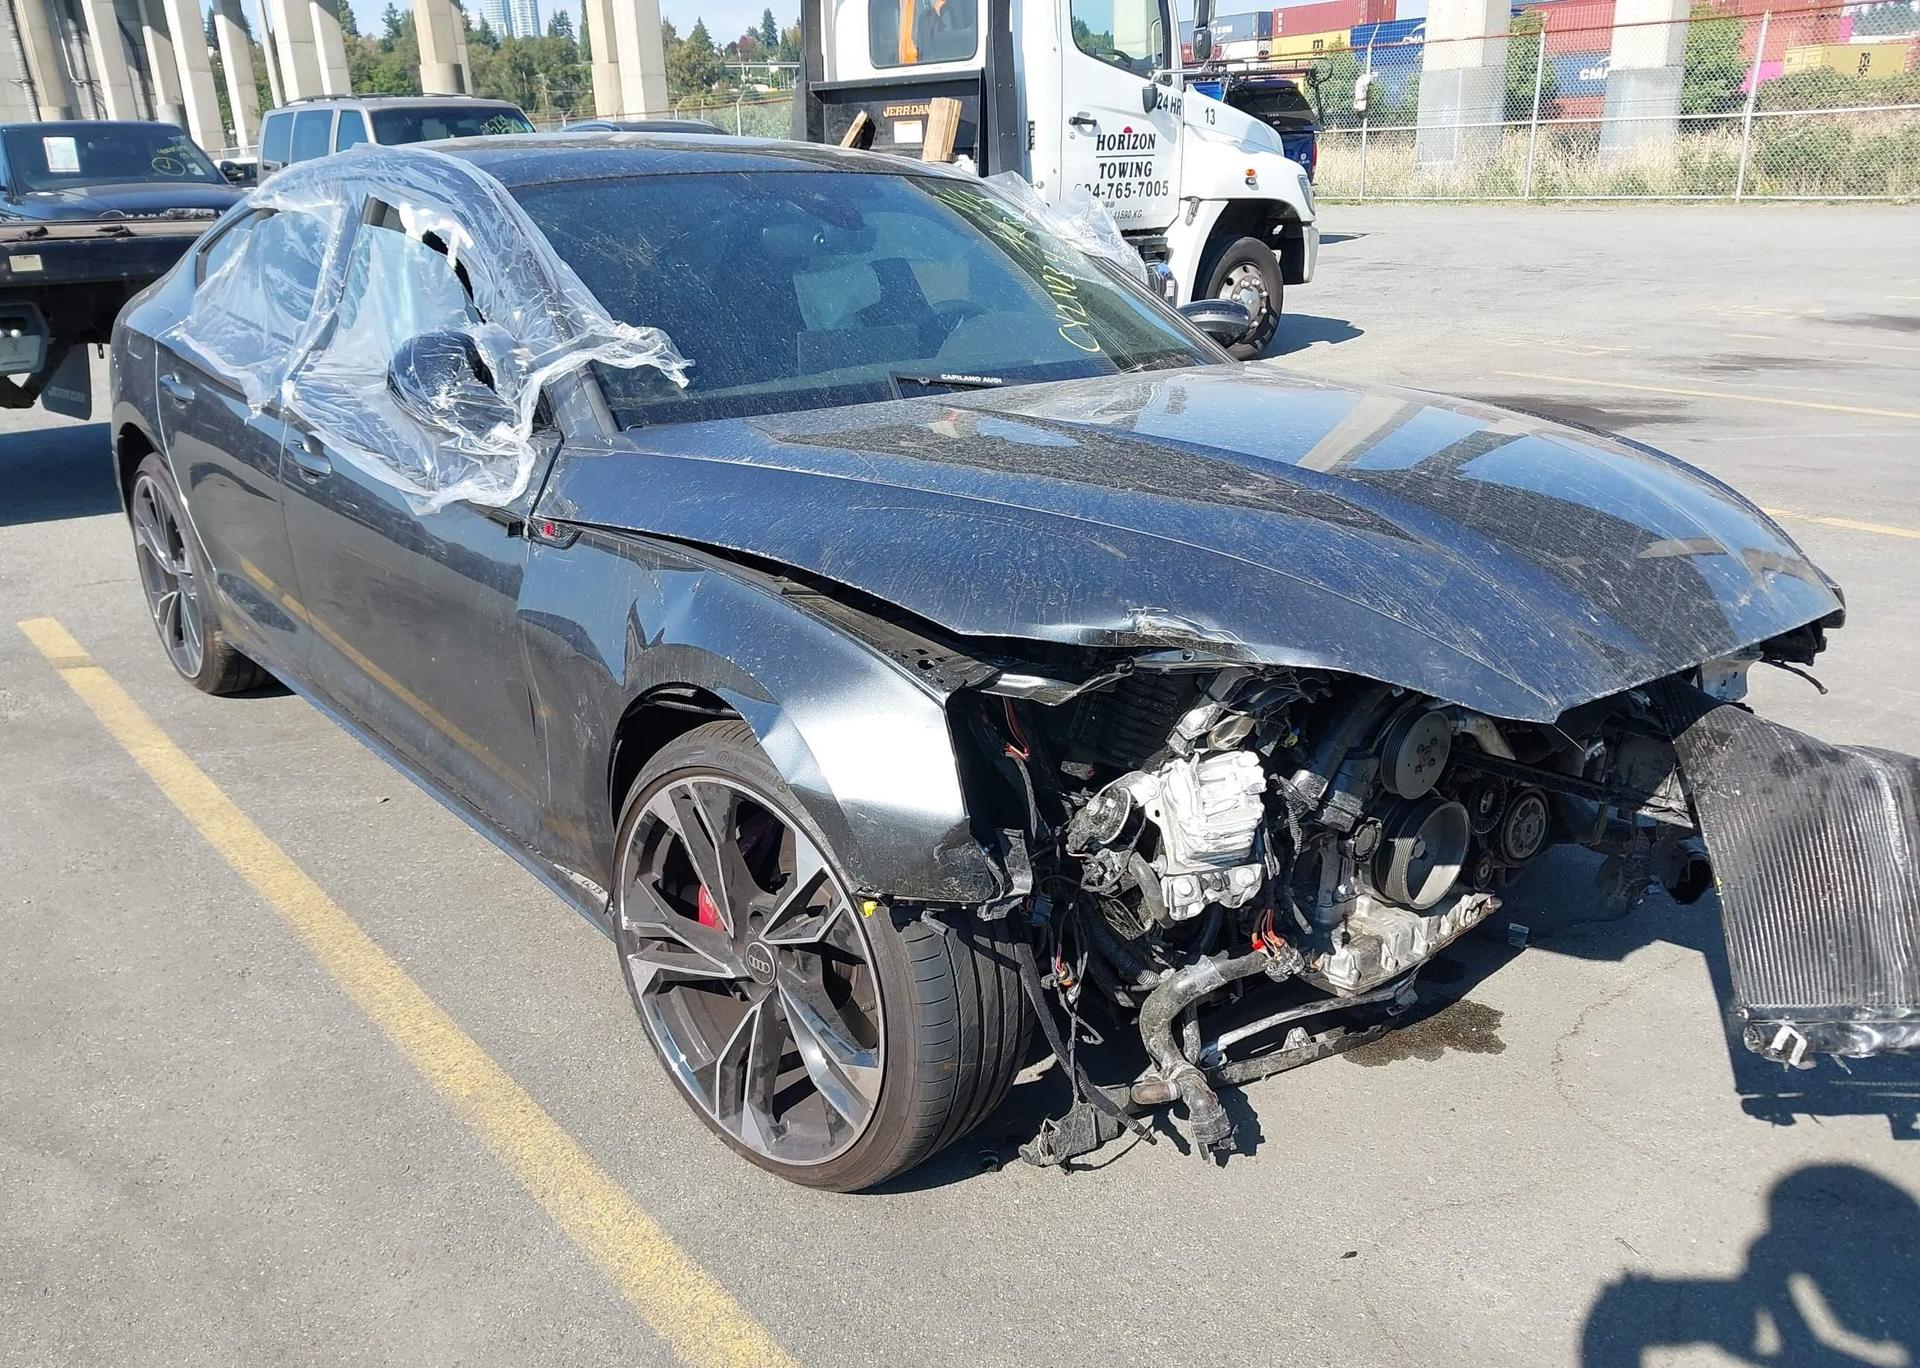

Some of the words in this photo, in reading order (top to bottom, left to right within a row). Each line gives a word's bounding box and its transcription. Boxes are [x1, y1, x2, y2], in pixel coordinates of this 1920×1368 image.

[1157, 92, 1169, 112] 24
[1170, 96, 1182, 116] HR
[1205, 107, 1216, 125] 13
[1096, 133, 1156, 151] HORIZON
[1099, 161, 1153, 179] TOWING
